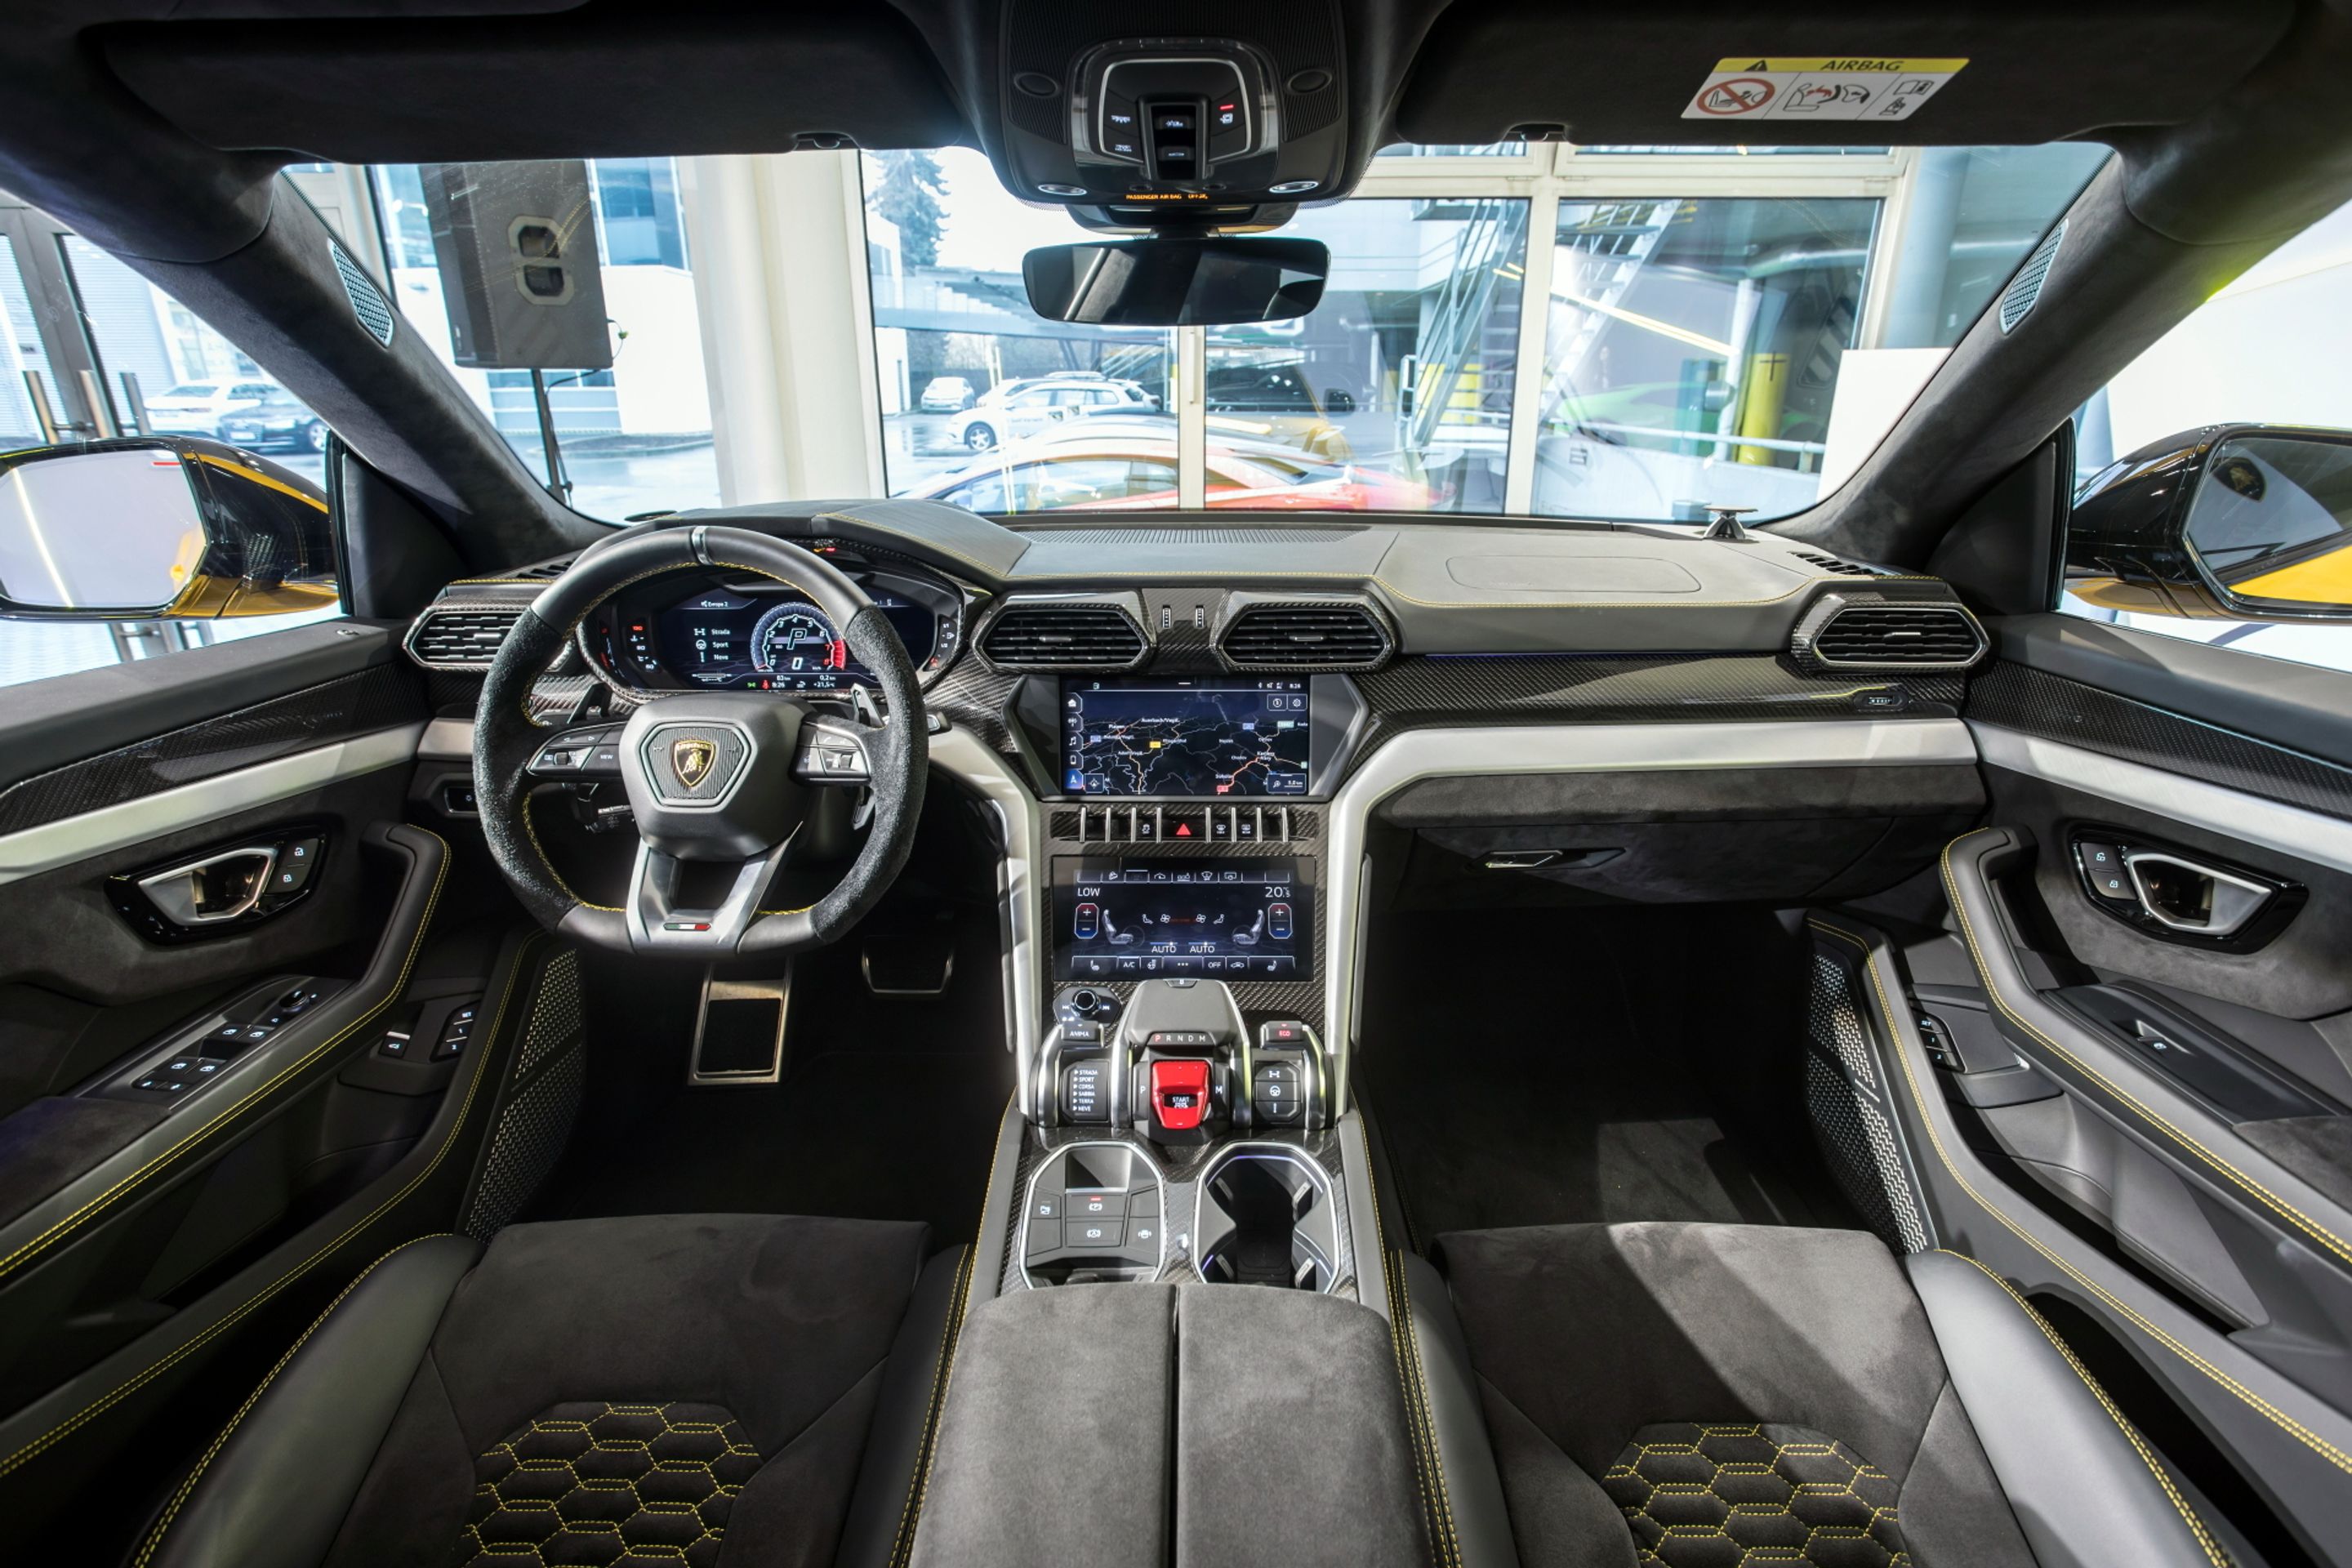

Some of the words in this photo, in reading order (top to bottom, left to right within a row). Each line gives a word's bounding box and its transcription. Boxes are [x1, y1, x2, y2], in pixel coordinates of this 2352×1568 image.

[1820, 60, 1904, 71] AIRBAG
[786, 628, 808, 650] P
[791, 657, 804, 670] 0
[1077, 887, 1101, 898] LOW
[1151, 945, 1177, 954] AUTO
[1189, 945, 1215, 954] AUTO
[1140, 1085, 1147, 1094] P
[1215, 1085, 1223, 1094] M
